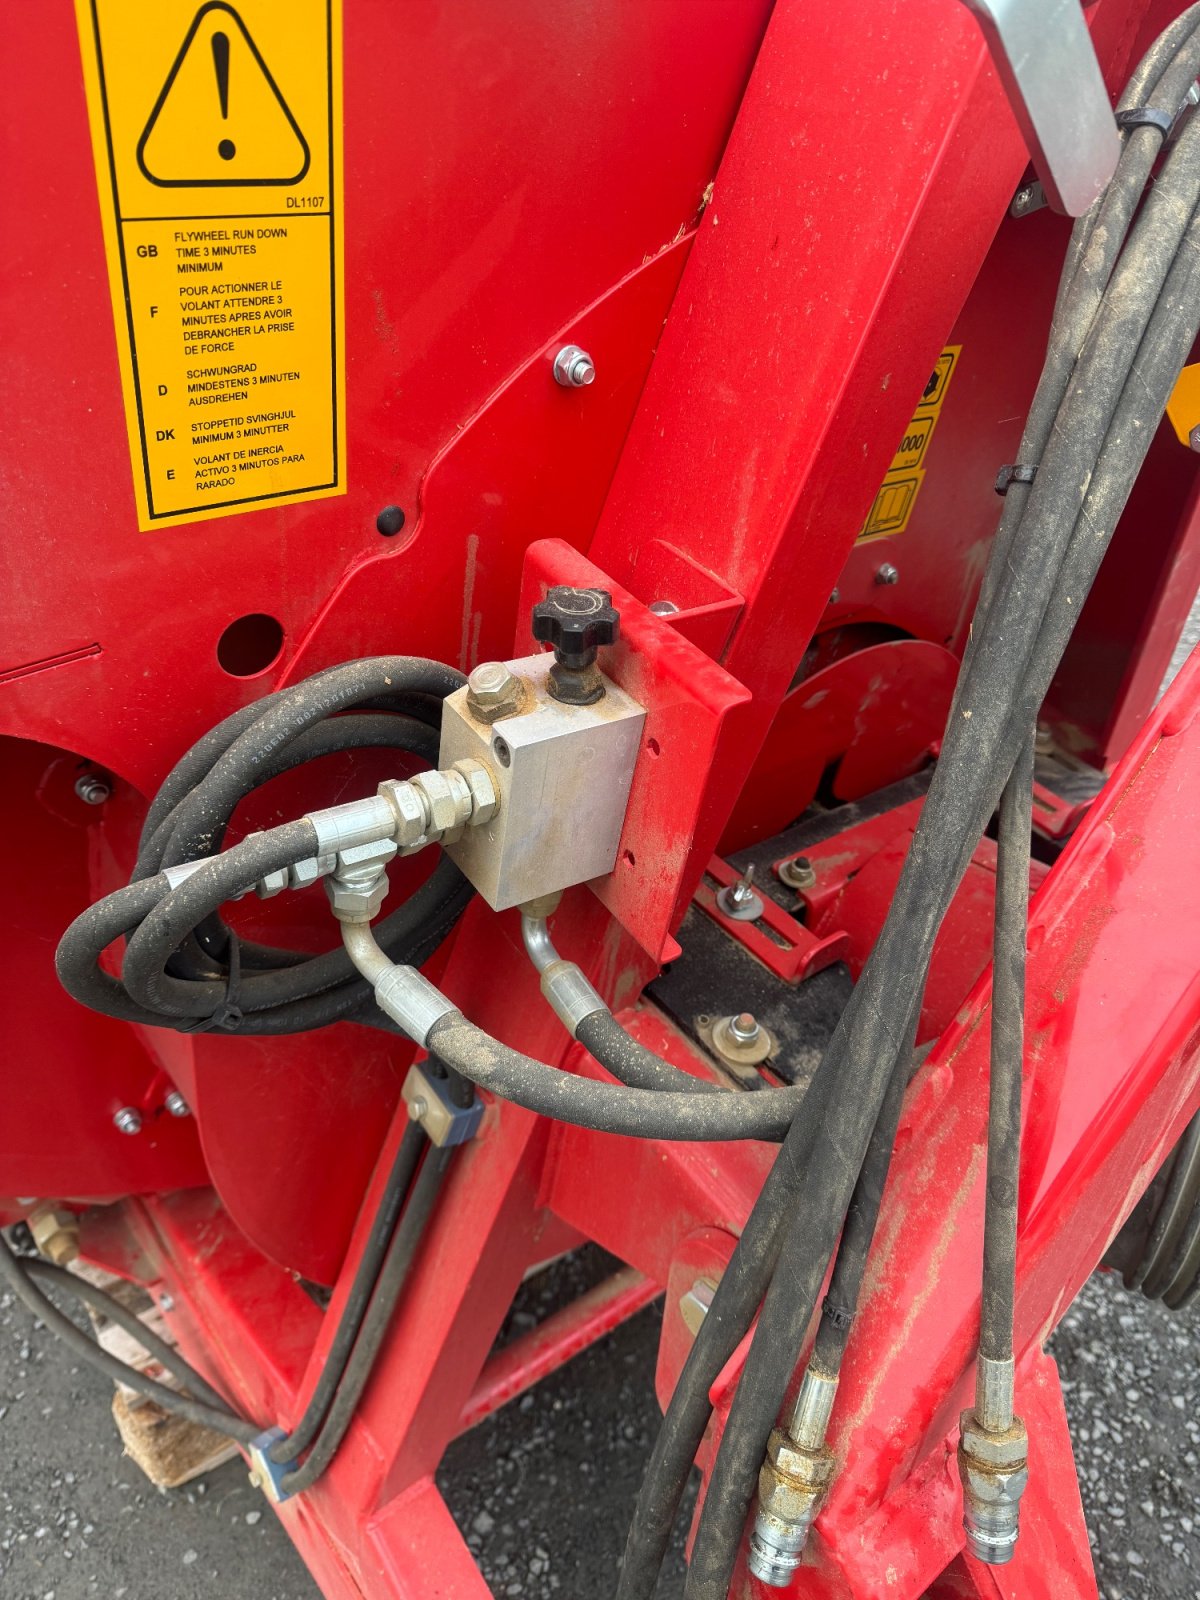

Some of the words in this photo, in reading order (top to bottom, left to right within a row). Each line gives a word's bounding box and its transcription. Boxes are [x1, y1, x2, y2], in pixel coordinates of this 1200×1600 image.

[286, 196, 325, 208] DL1107
[174, 230, 230, 242] FLYWHEEL
[233, 230, 254, 240] RUN
[257, 228, 288, 239] DOWN
[136, 245, 158, 258] GB
[176, 247, 201, 258] TIME
[203, 247, 210, 257] 3
[212, 245, 257, 256] MINUTES
[177, 262, 223, 274] MINIMUM
[179, 286, 209, 297] POUR
[212, 283, 269, 295] ACTIONNER
[270, 281, 282, 290] LE
[180, 301, 221, 312] VOLANT
[223, 296, 275, 309] ATTENDRE
[277, 295, 283, 304] 3
[150, 306, 159, 318] F
[182, 315, 227, 327] MINUTES
[229, 312, 261, 323] APRES
[263, 309, 293, 320] AVOIR
[183, 327, 251, 341] DEBRANCHER
[253, 326, 266, 335] LA
[267, 322, 295, 333] PRISE
[184, 346, 199, 356] DE
[201, 342, 235, 354] FORCE
[187, 364, 257, 379] SCHWUNGRAD
[187, 378, 250, 393] MINDESTENS
[252, 376, 258, 386] 3
[259, 372, 300, 384] MINUTEN
[157, 385, 168, 397] D
[189, 392, 248, 406] AUSDREHEN
[191, 418, 244, 431] STOPPETID
[246, 410, 296, 425] SVINGHJUL
[156, 429, 176, 442] DK
[192, 433, 234, 445] MINIMUM
[236, 430, 242, 439] 3
[244, 424, 289, 437] MINUTTER
[194, 452, 231, 466] VOLANT
[233, 449, 246, 460] DE
[248, 444, 284, 458] INERCIA
[195, 465, 230, 479] ACTIVO
[231, 463, 238, 473] 3
[239, 457, 280, 471] MINUTOS
[281, 453, 305, 465] PARA
[166, 469, 176, 480] E
[196, 477, 235, 491] RARADO
